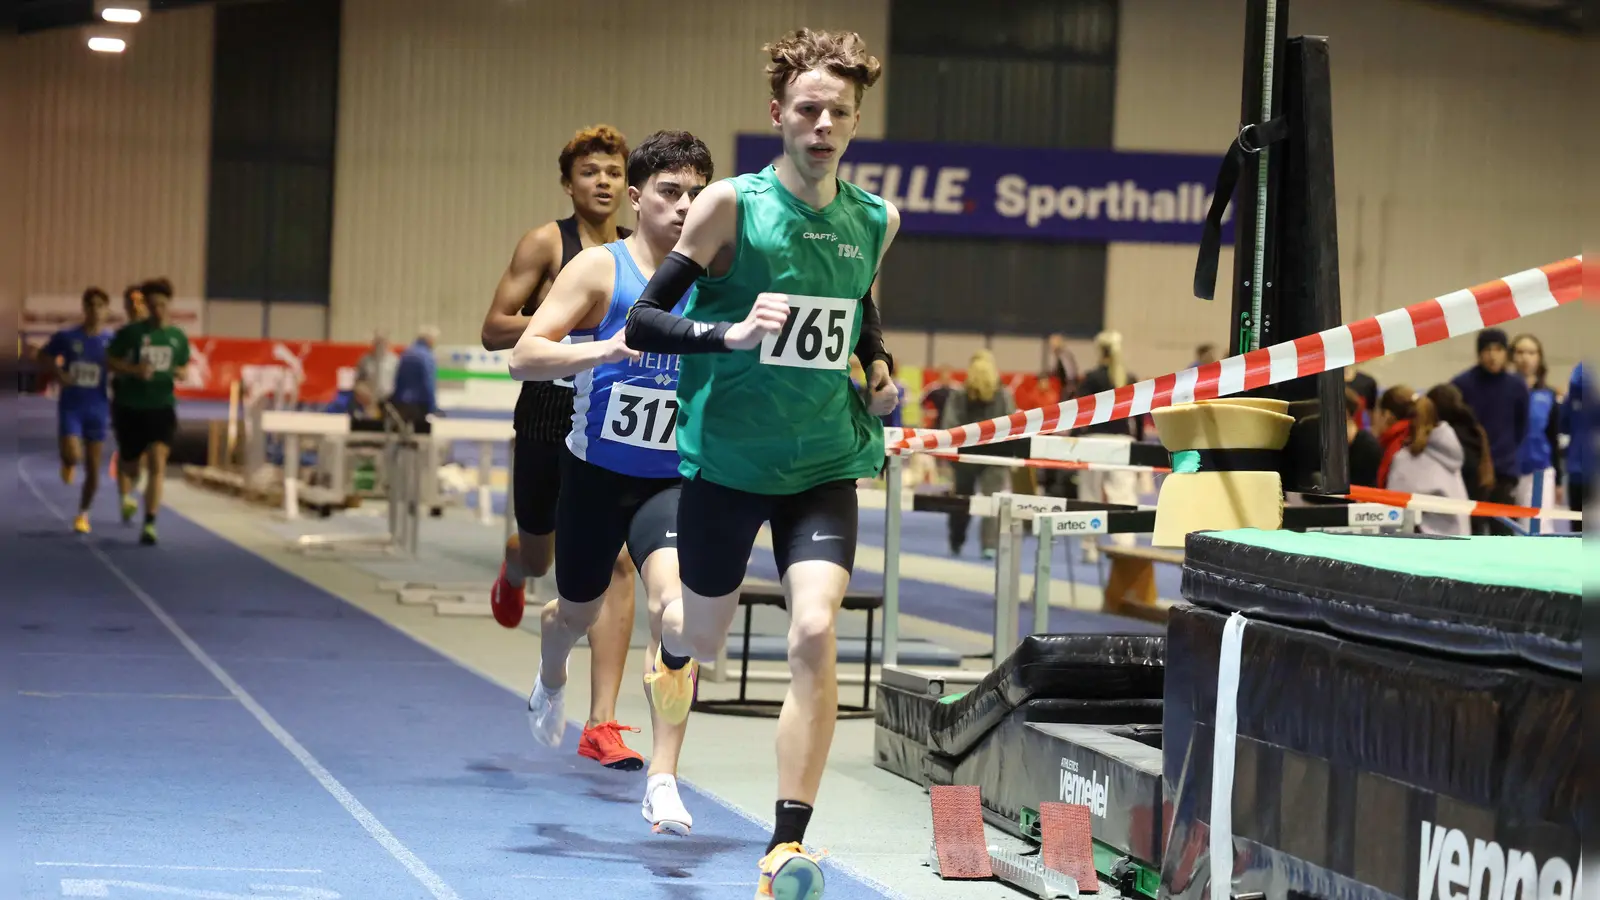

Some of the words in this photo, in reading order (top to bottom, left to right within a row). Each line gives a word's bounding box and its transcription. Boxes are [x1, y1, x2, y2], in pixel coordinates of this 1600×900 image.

[803, 232, 832, 241] CRAFT
[837, 243, 860, 259] TSV
[770, 306, 847, 363] 765
[612, 393, 680, 444] 317
[1057, 520, 1086, 530] artec
[1355, 512, 1385, 521] artec
[1060, 769, 1109, 819] vennekel
[1418, 820, 1583, 900] venne
